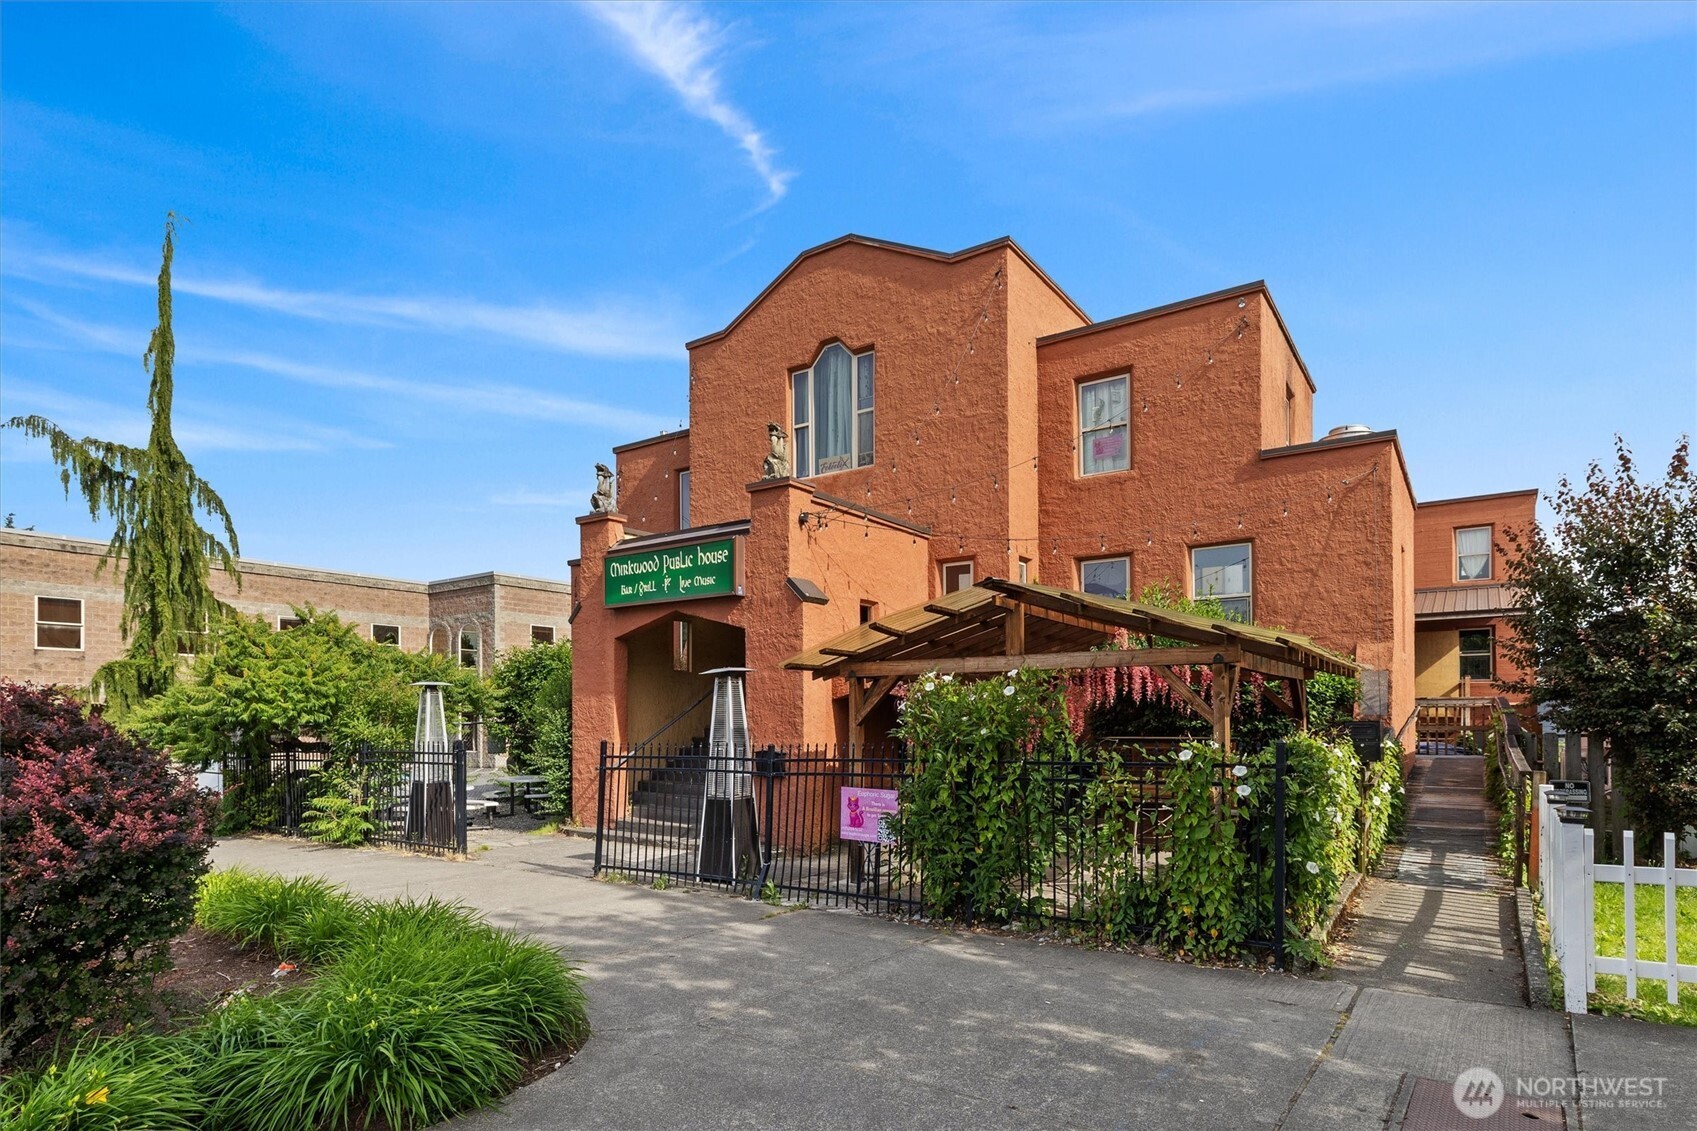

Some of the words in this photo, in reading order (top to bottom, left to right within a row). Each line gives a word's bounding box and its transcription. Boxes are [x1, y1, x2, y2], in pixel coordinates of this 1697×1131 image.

[610, 555, 660, 577] Mirkwood
[662, 551, 693, 576] Public
[679, 576, 692, 593] Live
[693, 576, 716, 587] Music
